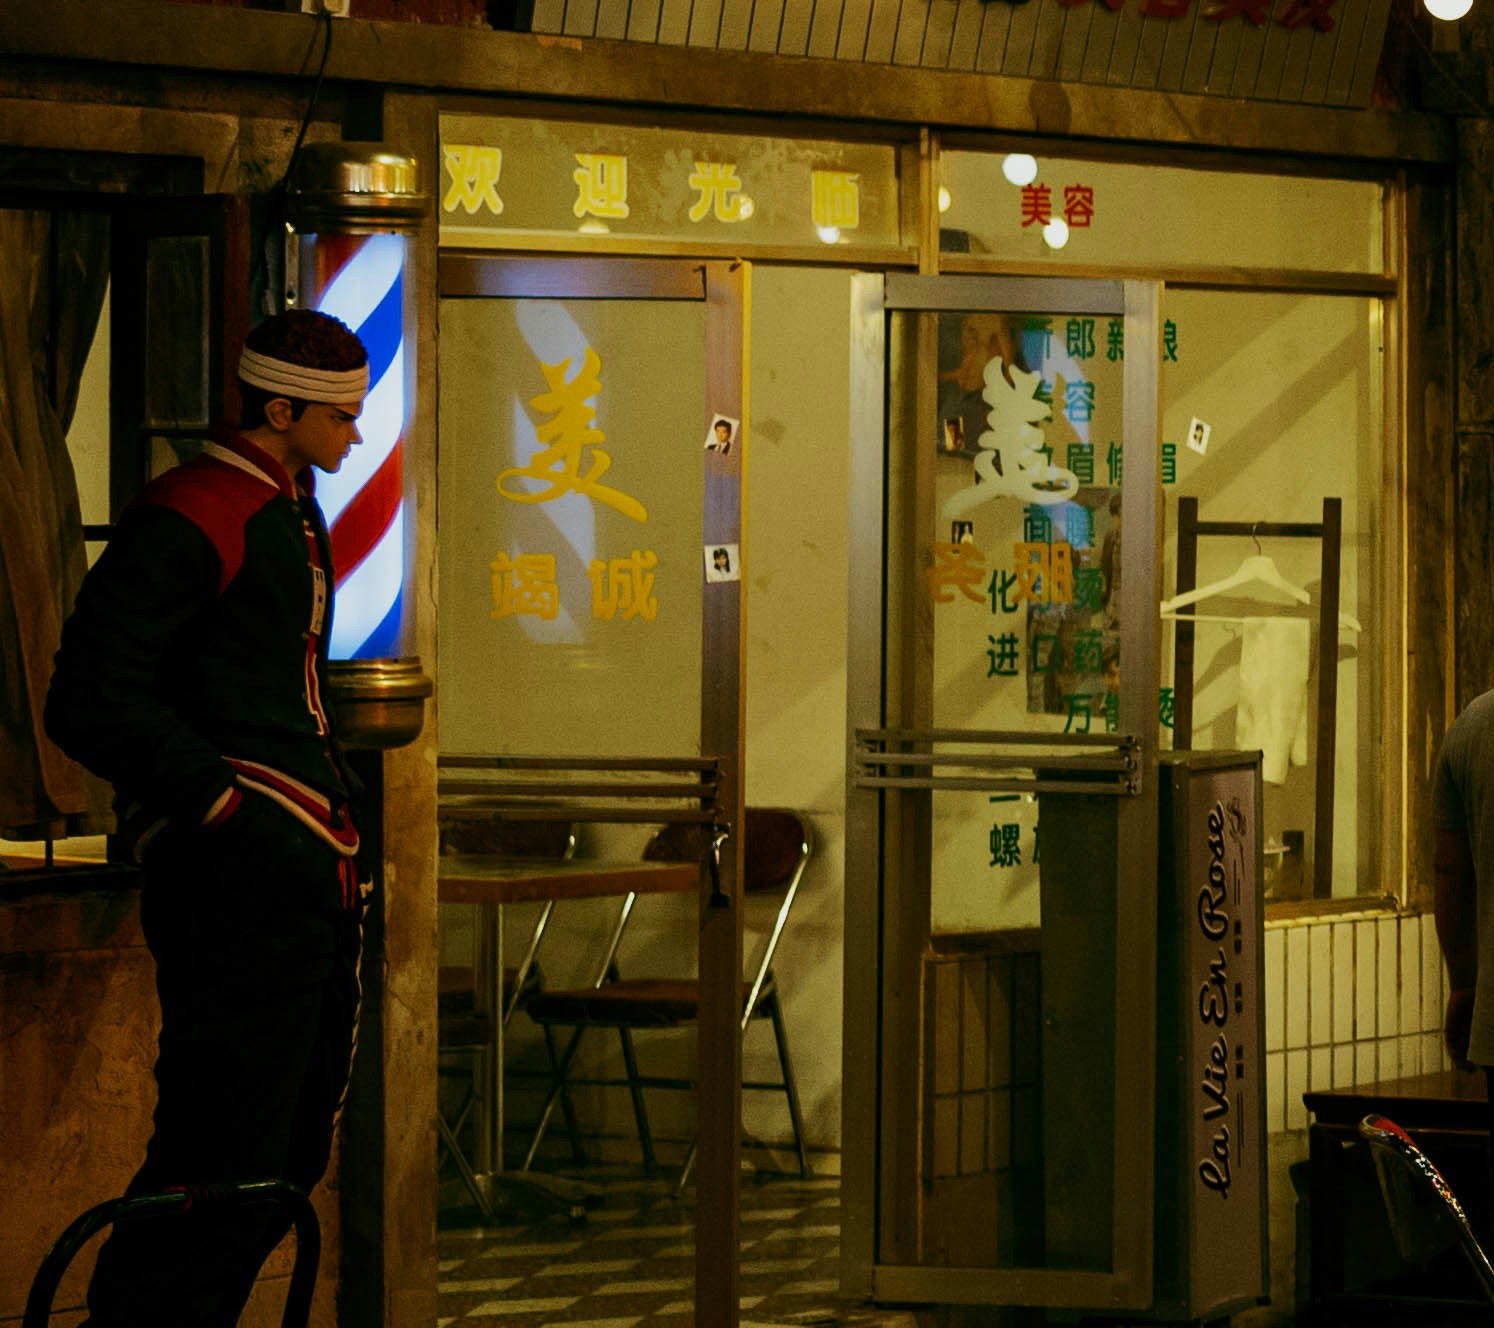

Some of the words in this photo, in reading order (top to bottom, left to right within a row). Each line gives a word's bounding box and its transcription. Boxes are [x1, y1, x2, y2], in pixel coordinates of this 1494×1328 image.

[443, 143, 861, 230] 欢迎光临
[1021, 183, 1095, 229] 美容
[495, 347, 649, 523] 美
[489, 548, 659, 621] 竭诚
[1198, 800, 1230, 942] Rose
[1200, 946, 1228, 1027] En
[1201, 1031, 1229, 1121] Vie
